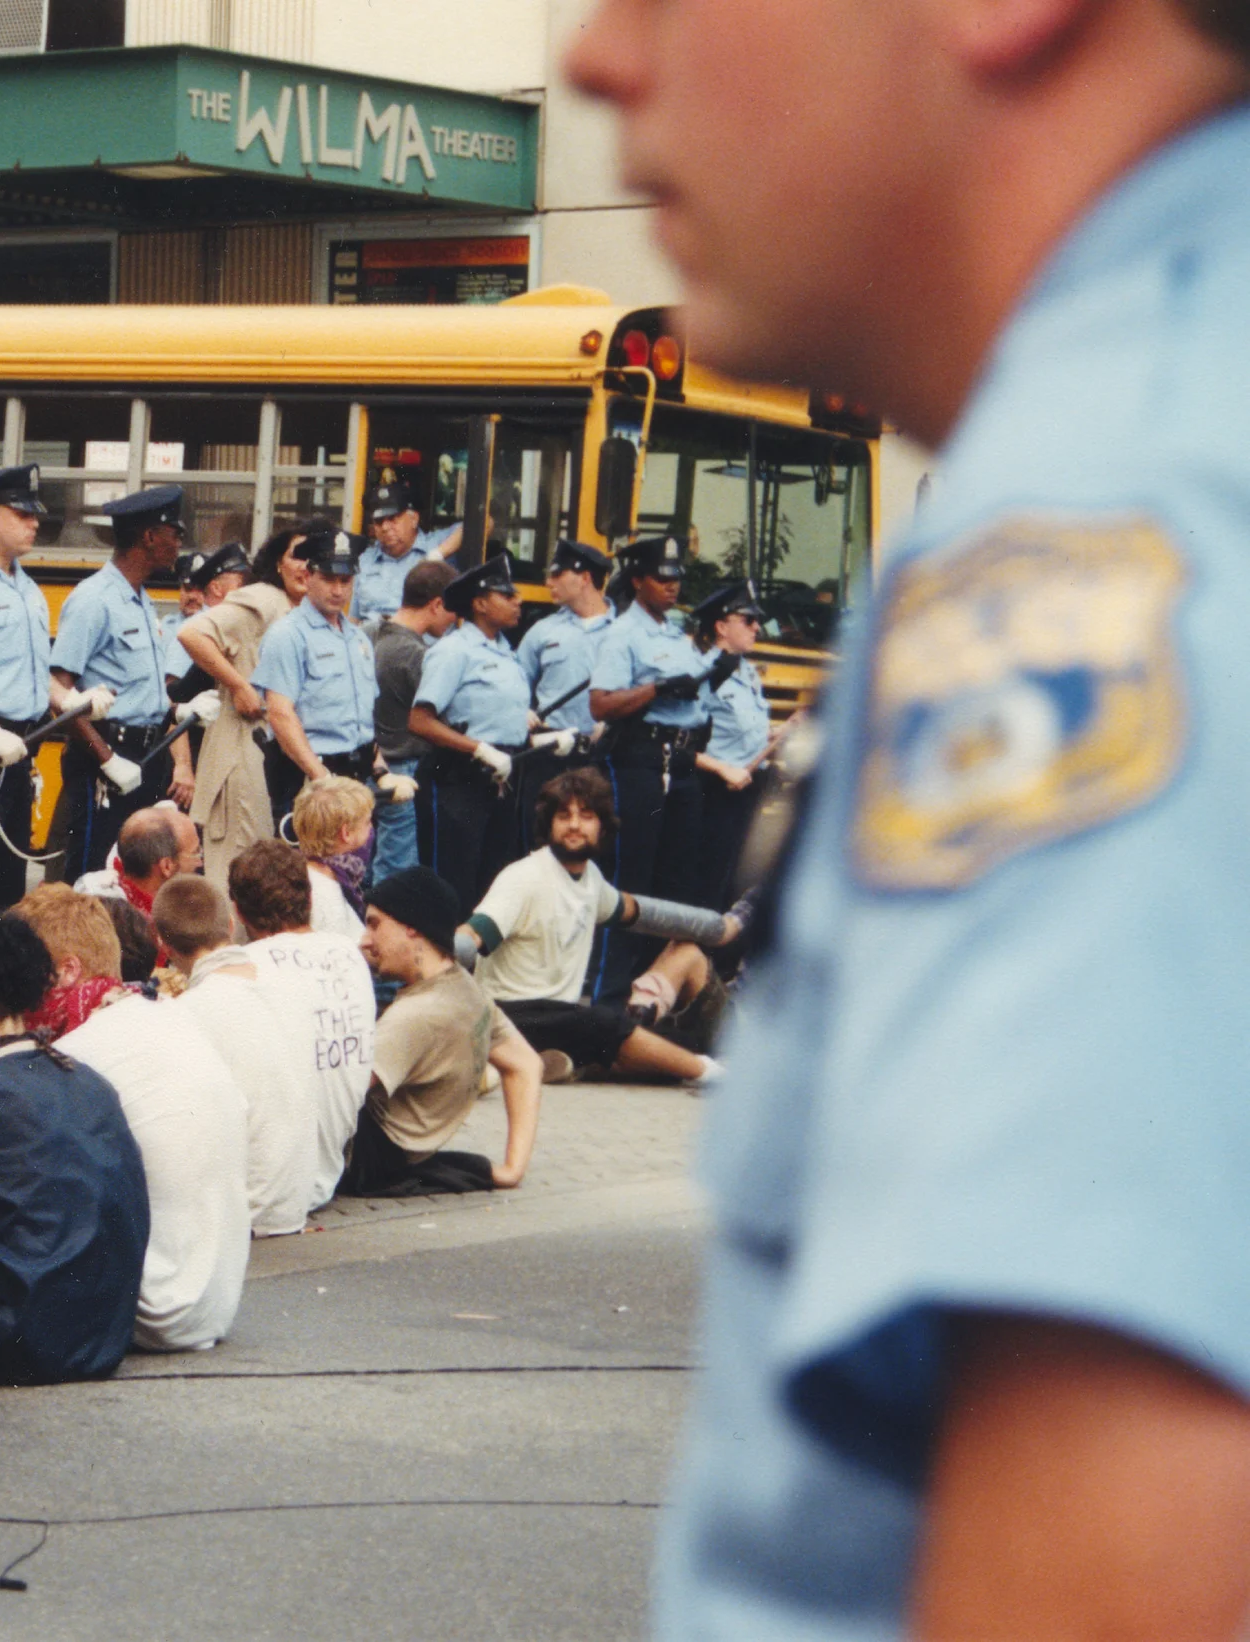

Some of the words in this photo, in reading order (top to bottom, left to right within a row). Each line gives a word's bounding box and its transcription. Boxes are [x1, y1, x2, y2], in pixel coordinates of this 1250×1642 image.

[187, 87, 232, 124] THE
[236, 69, 437, 185] WILMA
[430, 125, 518, 165] THEATER
[314, 1004, 364, 1035] THE
